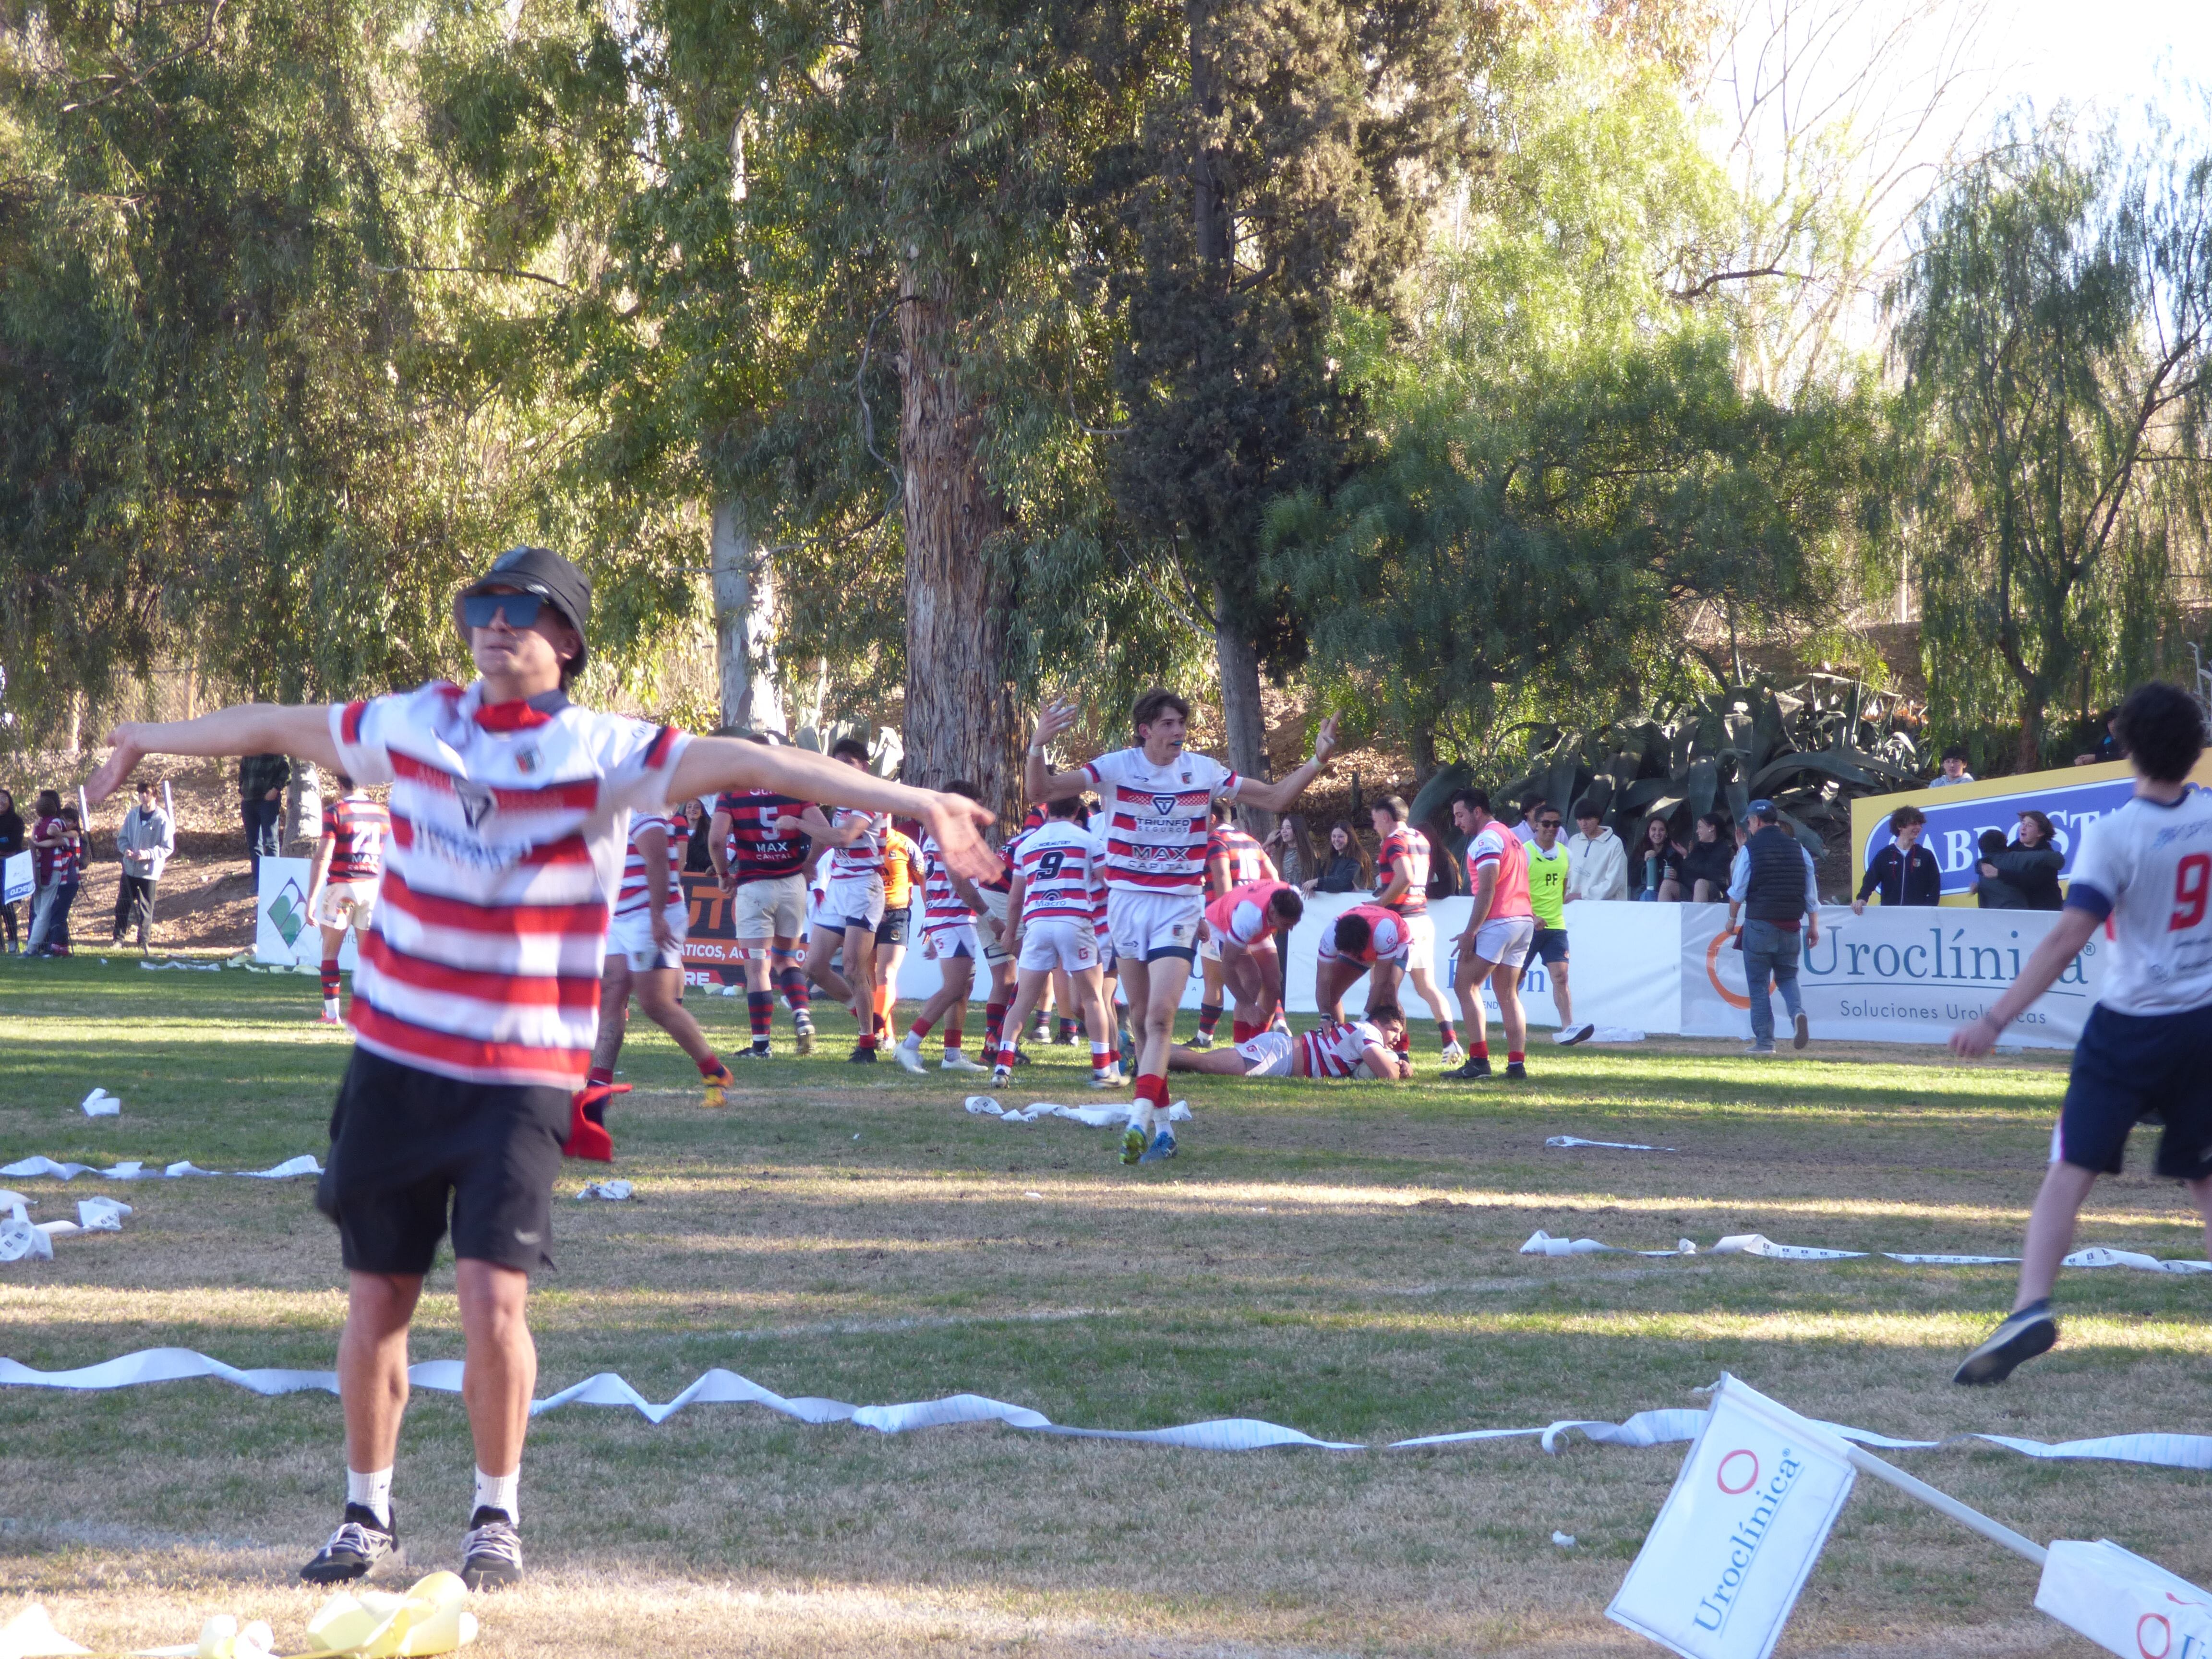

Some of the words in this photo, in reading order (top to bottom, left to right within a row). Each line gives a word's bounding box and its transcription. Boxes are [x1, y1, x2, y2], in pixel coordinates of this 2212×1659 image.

[759, 806, 781, 841] 5
[1136, 817, 1190, 827] TRIUNFO
[756, 842, 788, 853] MAX
[1132, 846, 1190, 860] MAX
[351, 854, 380, 865] MAX
[1035, 850, 1067, 881] 9
[1128, 861, 1192, 871] CAPITAL
[1546, 873, 1558, 886] PF
[2168, 853, 2211, 932] 9
[1079, 948, 1089, 960] G
[1840, 1000, 1938, 1019] Soluciones
[1947, 1004, 2046, 1024] Urolcas
